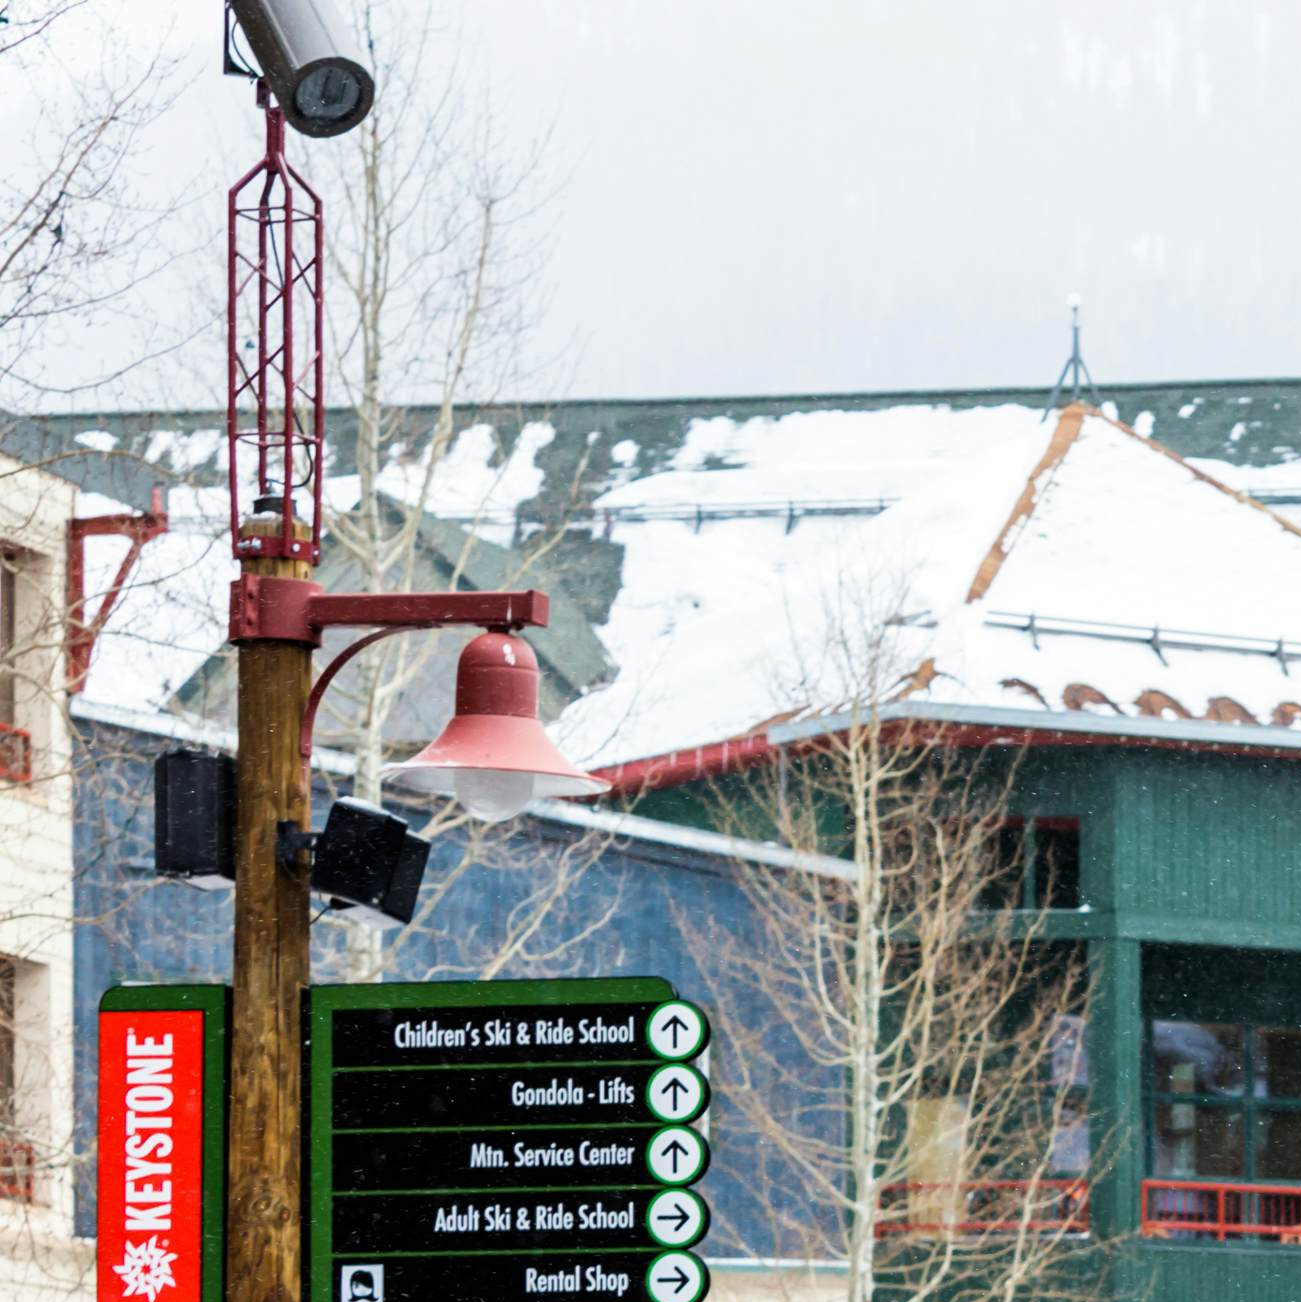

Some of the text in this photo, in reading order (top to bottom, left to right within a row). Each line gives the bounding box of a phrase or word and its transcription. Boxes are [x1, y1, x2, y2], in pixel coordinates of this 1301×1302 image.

[394, 1016, 634, 1048] Children's Ski & Ride School
[511, 1078, 584, 1106] Gondola
[599, 1076, 635, 1104] Lifts
[124, 1033, 174, 1231] KEYSTONE
[470, 1140, 635, 1168] Mtn. Service Center
[434, 1201, 634, 1232] Adult Ski & Ride School
[526, 1264, 629, 1297] Rental Shop
